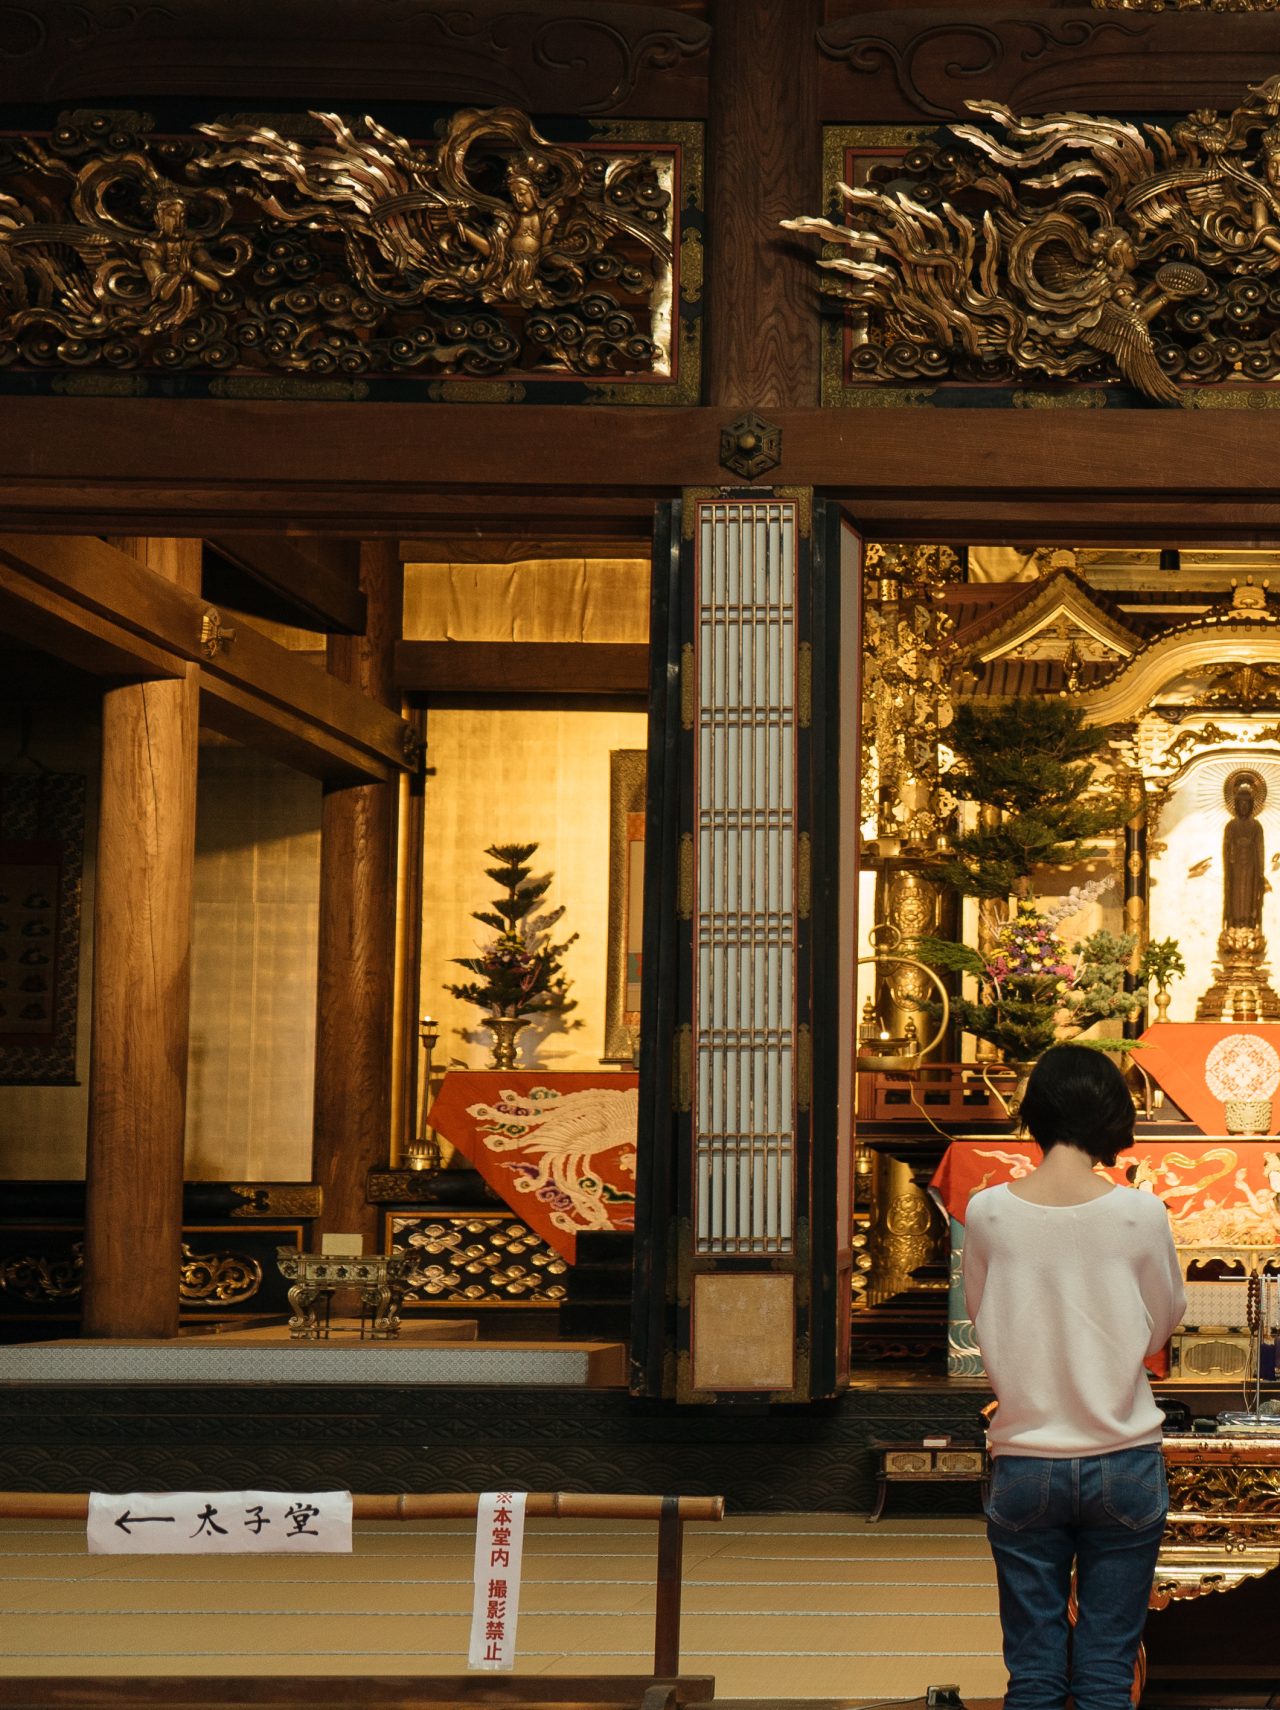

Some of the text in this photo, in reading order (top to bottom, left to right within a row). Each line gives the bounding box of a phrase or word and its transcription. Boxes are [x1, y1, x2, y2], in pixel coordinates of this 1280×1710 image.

[189, 1503, 320, 1539] 太子堂
[483, 1578, 508, 1661] 撮影禁止
